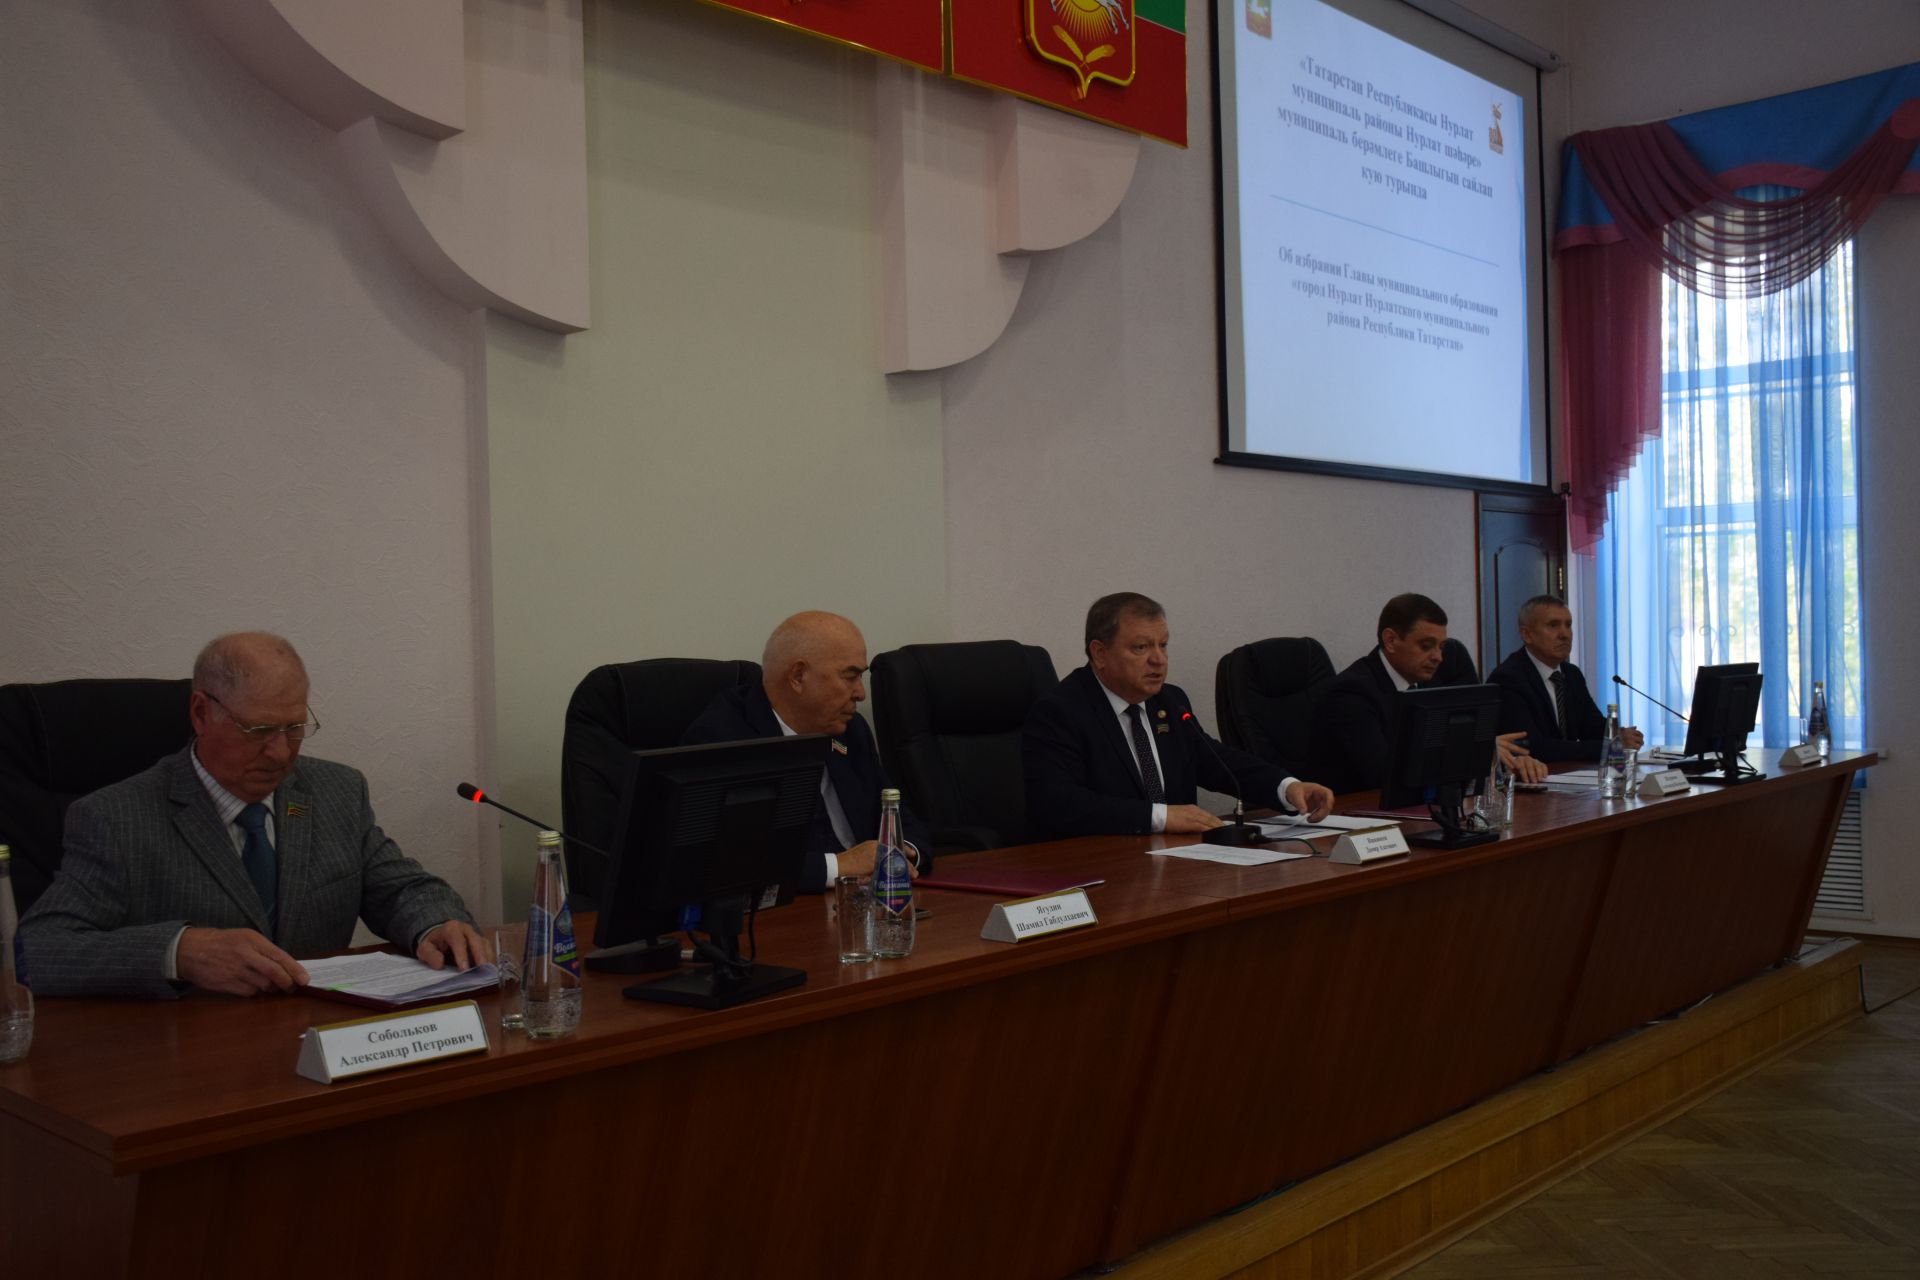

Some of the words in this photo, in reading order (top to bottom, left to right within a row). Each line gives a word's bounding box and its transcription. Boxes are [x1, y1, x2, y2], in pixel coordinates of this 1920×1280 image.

[1292, 83, 1361, 121] муниципаль
[1364, 112, 1402, 138] районы
[1406, 125, 1441, 154] Нурлат
[1300, 56, 1363, 95] «Татарстан
[1367, 82, 1437, 126] Республикасы
[1440, 114, 1474, 141] Нурлат
[1278, 107, 1348, 144] муниципаль
[1352, 131, 1403, 165] берәмлеге
[1406, 153, 1459, 186] Башлыгын
[1462, 178, 1493, 198] сайлап
[1362, 166, 1382, 185] кую
[1386, 177, 1427, 200] турында
[1279, 246, 1293, 264] Об
[1296, 254, 1341, 276] избрании
[1344, 264, 1374, 285] Главы
[1377, 276, 1448, 304] муниципального
[1450, 294, 1498, 317] образования
[1292, 279, 1325, 297] «город
[1328, 283, 1362, 306] Нурлат
[1365, 293, 1421, 320] Нурлатского
[1424, 311, 1490, 336] муниципального
[1327, 310, 1360, 329] района
[1363, 316, 1414, 341] Республики
[1417, 329, 1464, 351] Татарстан»
[1016, 920, 1043, 931] Шамил
[1036, 904, 1061, 914] Ягудин
[340, 1046, 409, 1067] Александр
[412, 1033, 473, 1053] Петрович
[368, 1024, 437, 1043] Собольков
